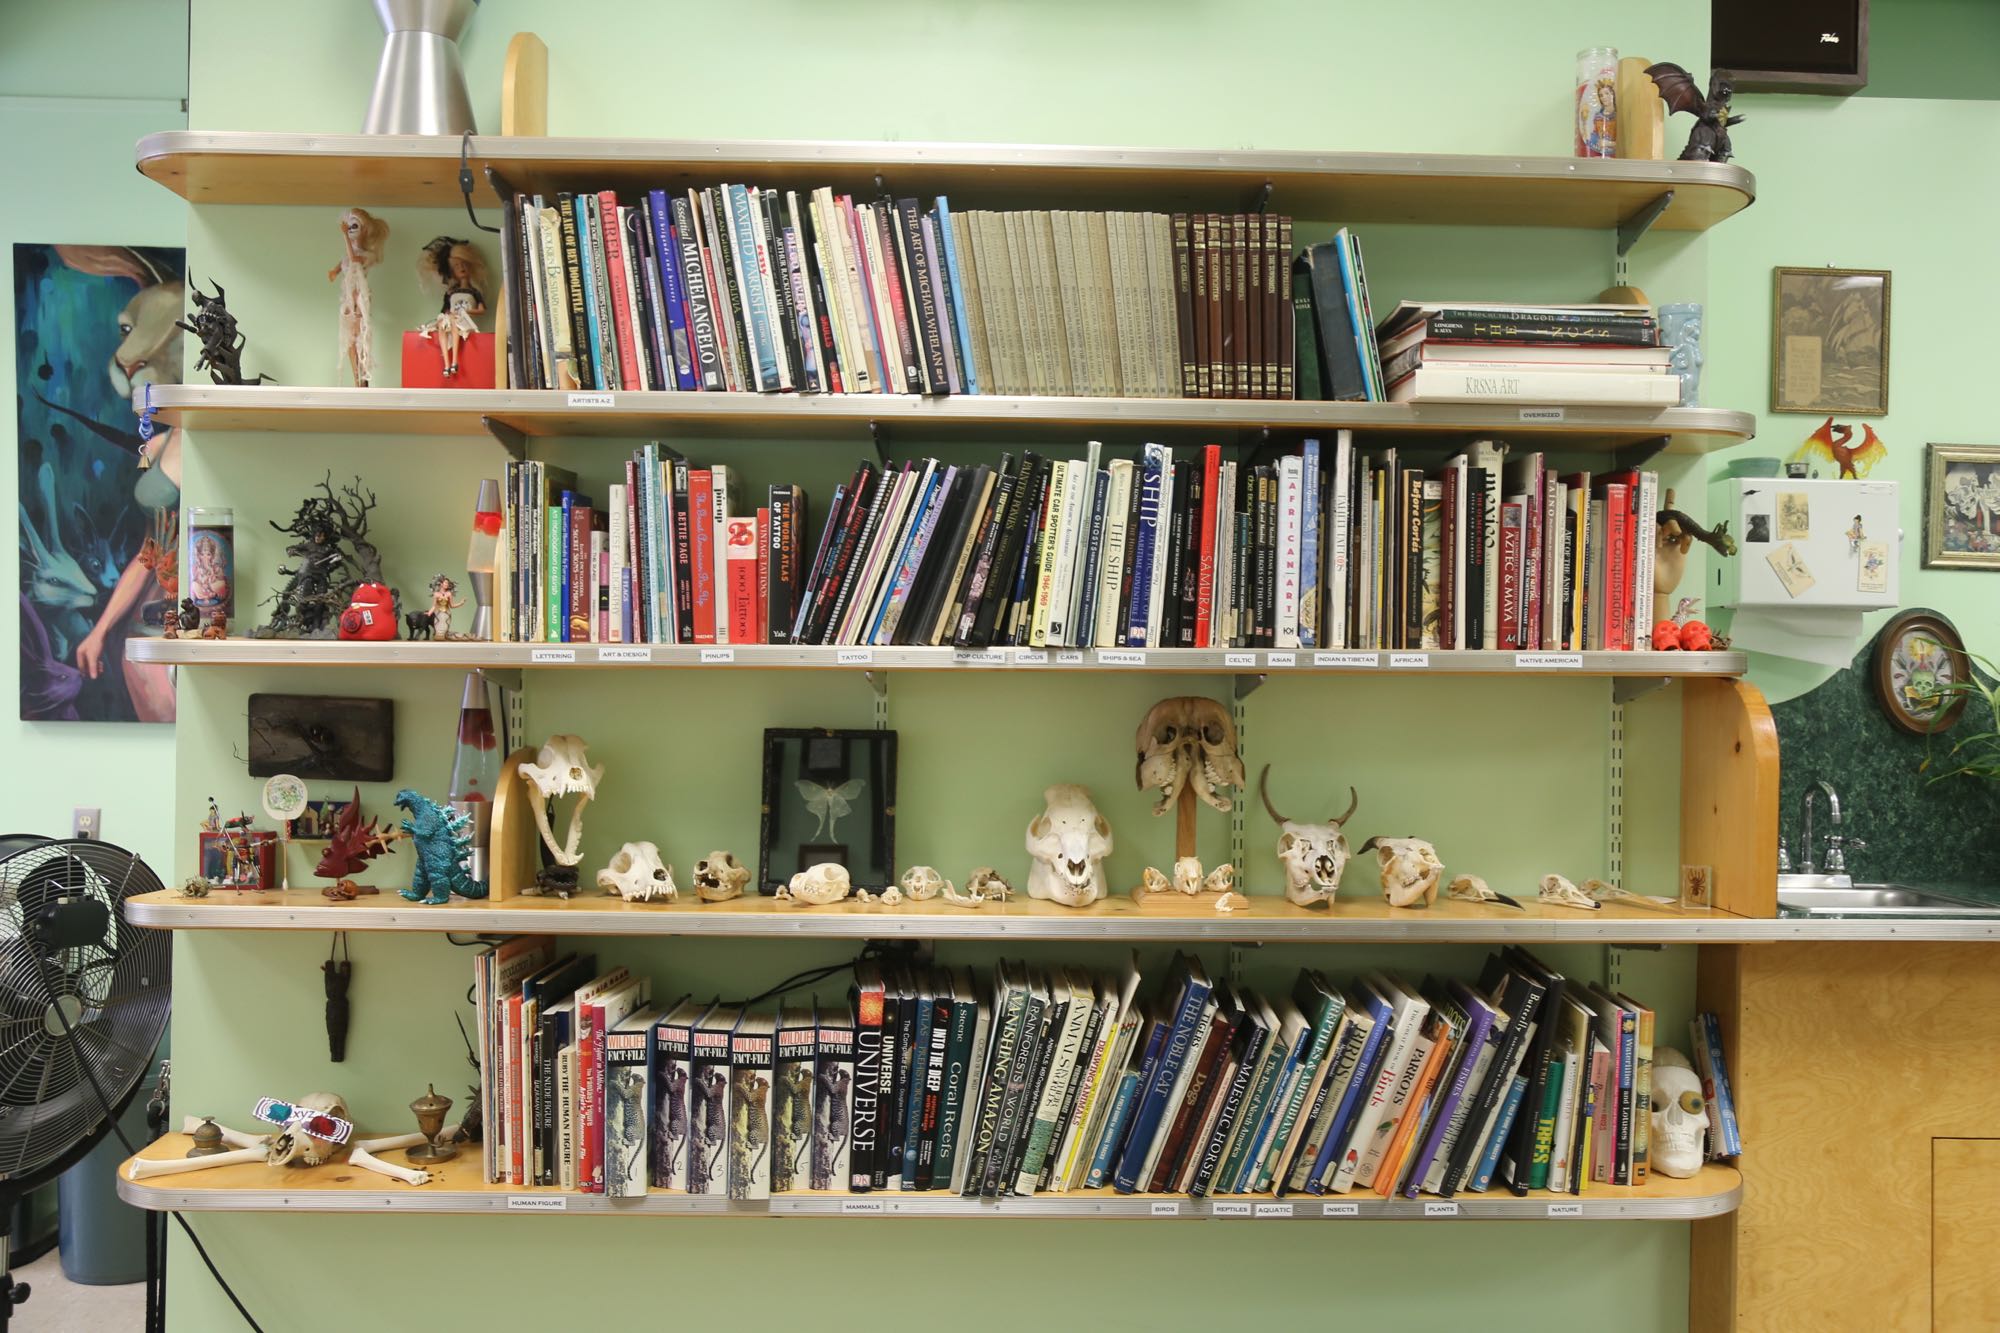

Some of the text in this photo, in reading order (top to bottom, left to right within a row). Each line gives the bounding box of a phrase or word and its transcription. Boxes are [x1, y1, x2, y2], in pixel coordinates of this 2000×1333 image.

[676, 201, 715, 364] Essential MICHELANGELO
[734, 192, 767, 345] MAXFIELD PARRISH LUDWIG
[786, 232, 806, 315] DIEGO RIVERA
[907, 207, 943, 366] THE ART OF MICHAEL WHELAN
[820, 316, 832, 348] SKULLS
[1466, 377, 1520, 395] KRSNA ART
[714, 488, 725, 523] pin-up
[774, 502, 780, 513] OF
[1006, 461, 1032, 530] PAINTED PONIES
[1140, 473, 1161, 527] SHIP
[1411, 480, 1421, 553] Before Cortés
[678, 512, 688, 564] BETTIE PAGE
[781, 502, 790, 581] THE WORLD ATLAS
[1039, 465, 1064, 606] ULTIMATE CAR SPOTTER'S GUIDE 1946-1969
[1091, 514, 1101, 551] GHOSTS
[1106, 521, 1124, 590] THE SHIP
[1564, 546, 1571, 557] OF
[611, 512, 621, 615] CHINESE CALLIGRAPHY
[760, 523, 768, 597] VINTAGE TATTOOS
[1131, 532, 1145, 615] MARITIME ADVENTURE
[1504, 530, 1515, 621] AZTEC & MAYA
[1611, 513, 1626, 629] The Conquistadors
[739, 566, 749, 638] 1000 Tattoos
[1198, 555, 1212, 620] SAMURAI
[658, 1027, 689, 1042] WILDLIFE
[819, 1030, 853, 1044] WILDLIFE
[1060, 1000, 1087, 1069] ANIMALS
[1191, 1013, 1211, 1048] TIGERS
[1515, 993, 1540, 1033] Butterfly
[607, 1034, 646, 1049] WILDLIFE
[608, 1050, 645, 1061] FACT-FILE
[659, 1041, 688, 1053] FACT-FILE
[694, 1033, 728, 1047] WILDLIFE
[694, 1048, 727, 1057] FACT-FILE
[733, 1038, 771, 1052] WILDLIFE
[733, 1053, 770, 1064] FACT-FILE
[779, 1030, 815, 1045] WILDLIFE
[780, 1045, 814, 1057] FACT-FILE
[820, 1044, 852, 1054] FACT-FILE
[926, 1028, 947, 1091] INTO THE DEEP
[1155, 995, 1204, 1098] THE NOBLE CAT
[1336, 1027, 1367, 1079] BIRDS
[879, 1036, 895, 1094] UNIVERSE
[909, 1005, 931, 1148] ATLAS PREHISTORIC WORLD
[940, 1010, 968, 1158] Steene Coral Reefs
[977, 994, 1023, 1154] VANISHING AMAZON
[999, 1005, 1040, 1142] RAINFORESTS WORLD
[1072, 1040, 1106, 1127] DRAWING ANIMALS
[1279, 1003, 1341, 1140] REPTILES & AMPHIBIANS
[1350, 1062, 1368, 1088] BIRDS
[1392, 1048, 1426, 1106] PARROTS
[1452, 1067, 1471, 1097] FISHES
[1623, 1038, 1633, 1086] Waterlilies
[543, 1059, 552, 1129] THE NUDE FIGURE
[561, 1054, 572, 1165] RUBY THE HUMAN FIGURE
[852, 1030, 881, 1151] UNIVERSE
[1186, 1072, 1207, 1105] Dogs
[1369, 1069, 1396, 1107] Birds
[1200, 1062, 1253, 1179] MAJESTIC HORSE
[1533, 1117, 1556, 1164] TREES
[1621, 1107, 1630, 1140] Lotuses
[677, 1161, 684, 1171] 2
[716, 1164, 724, 1176] 3
[800, 1162, 808, 1171] 5
[846, 1203, 880, 1211] MAMMALS
[1155, 1205, 1175, 1213] BIRDS
[1216, 1205, 1247, 1213] REPTILES
[1257, 1206, 1291, 1214] AQUATIC
[1428, 1205, 1455, 1213] PLANTS
